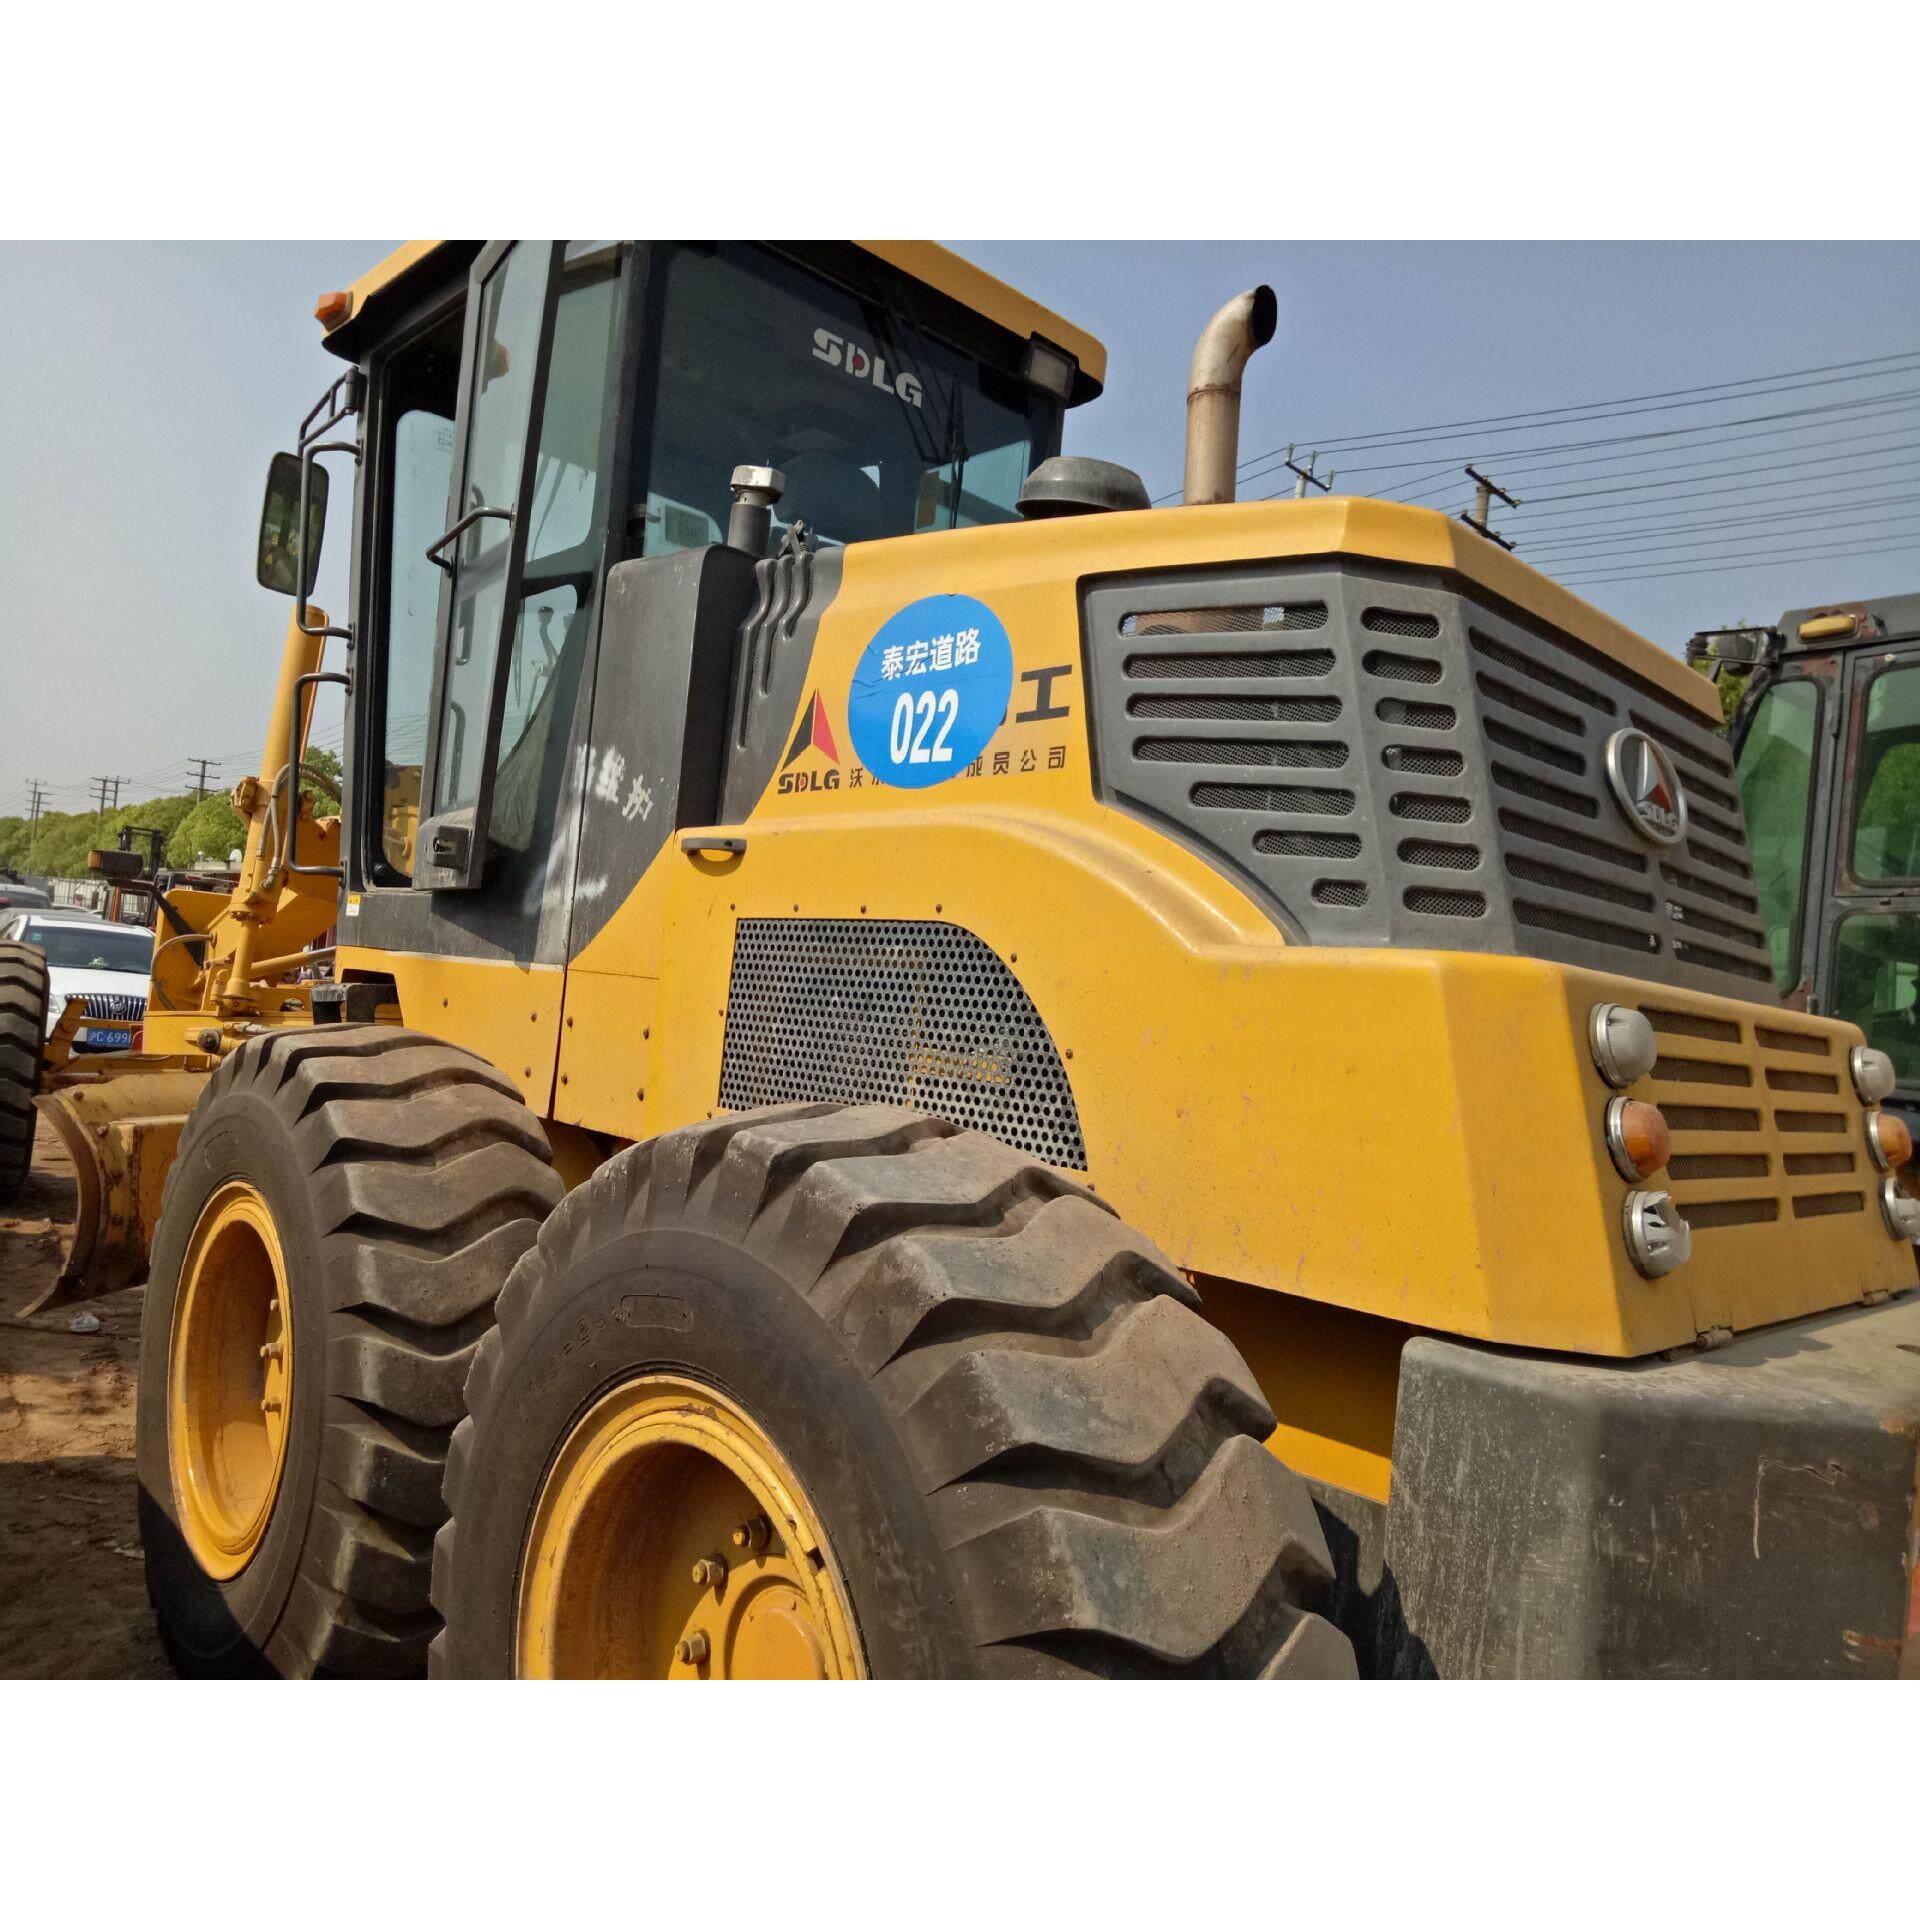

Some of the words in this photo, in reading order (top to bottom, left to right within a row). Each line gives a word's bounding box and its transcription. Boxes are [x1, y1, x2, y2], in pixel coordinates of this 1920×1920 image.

[812, 328, 922, 408] SDLG
[881, 627, 981, 681] 泰宏道路
[890, 688, 959, 765] 022
[999, 664, 1073, 727] 工
[778, 768, 840, 794] SDLG
